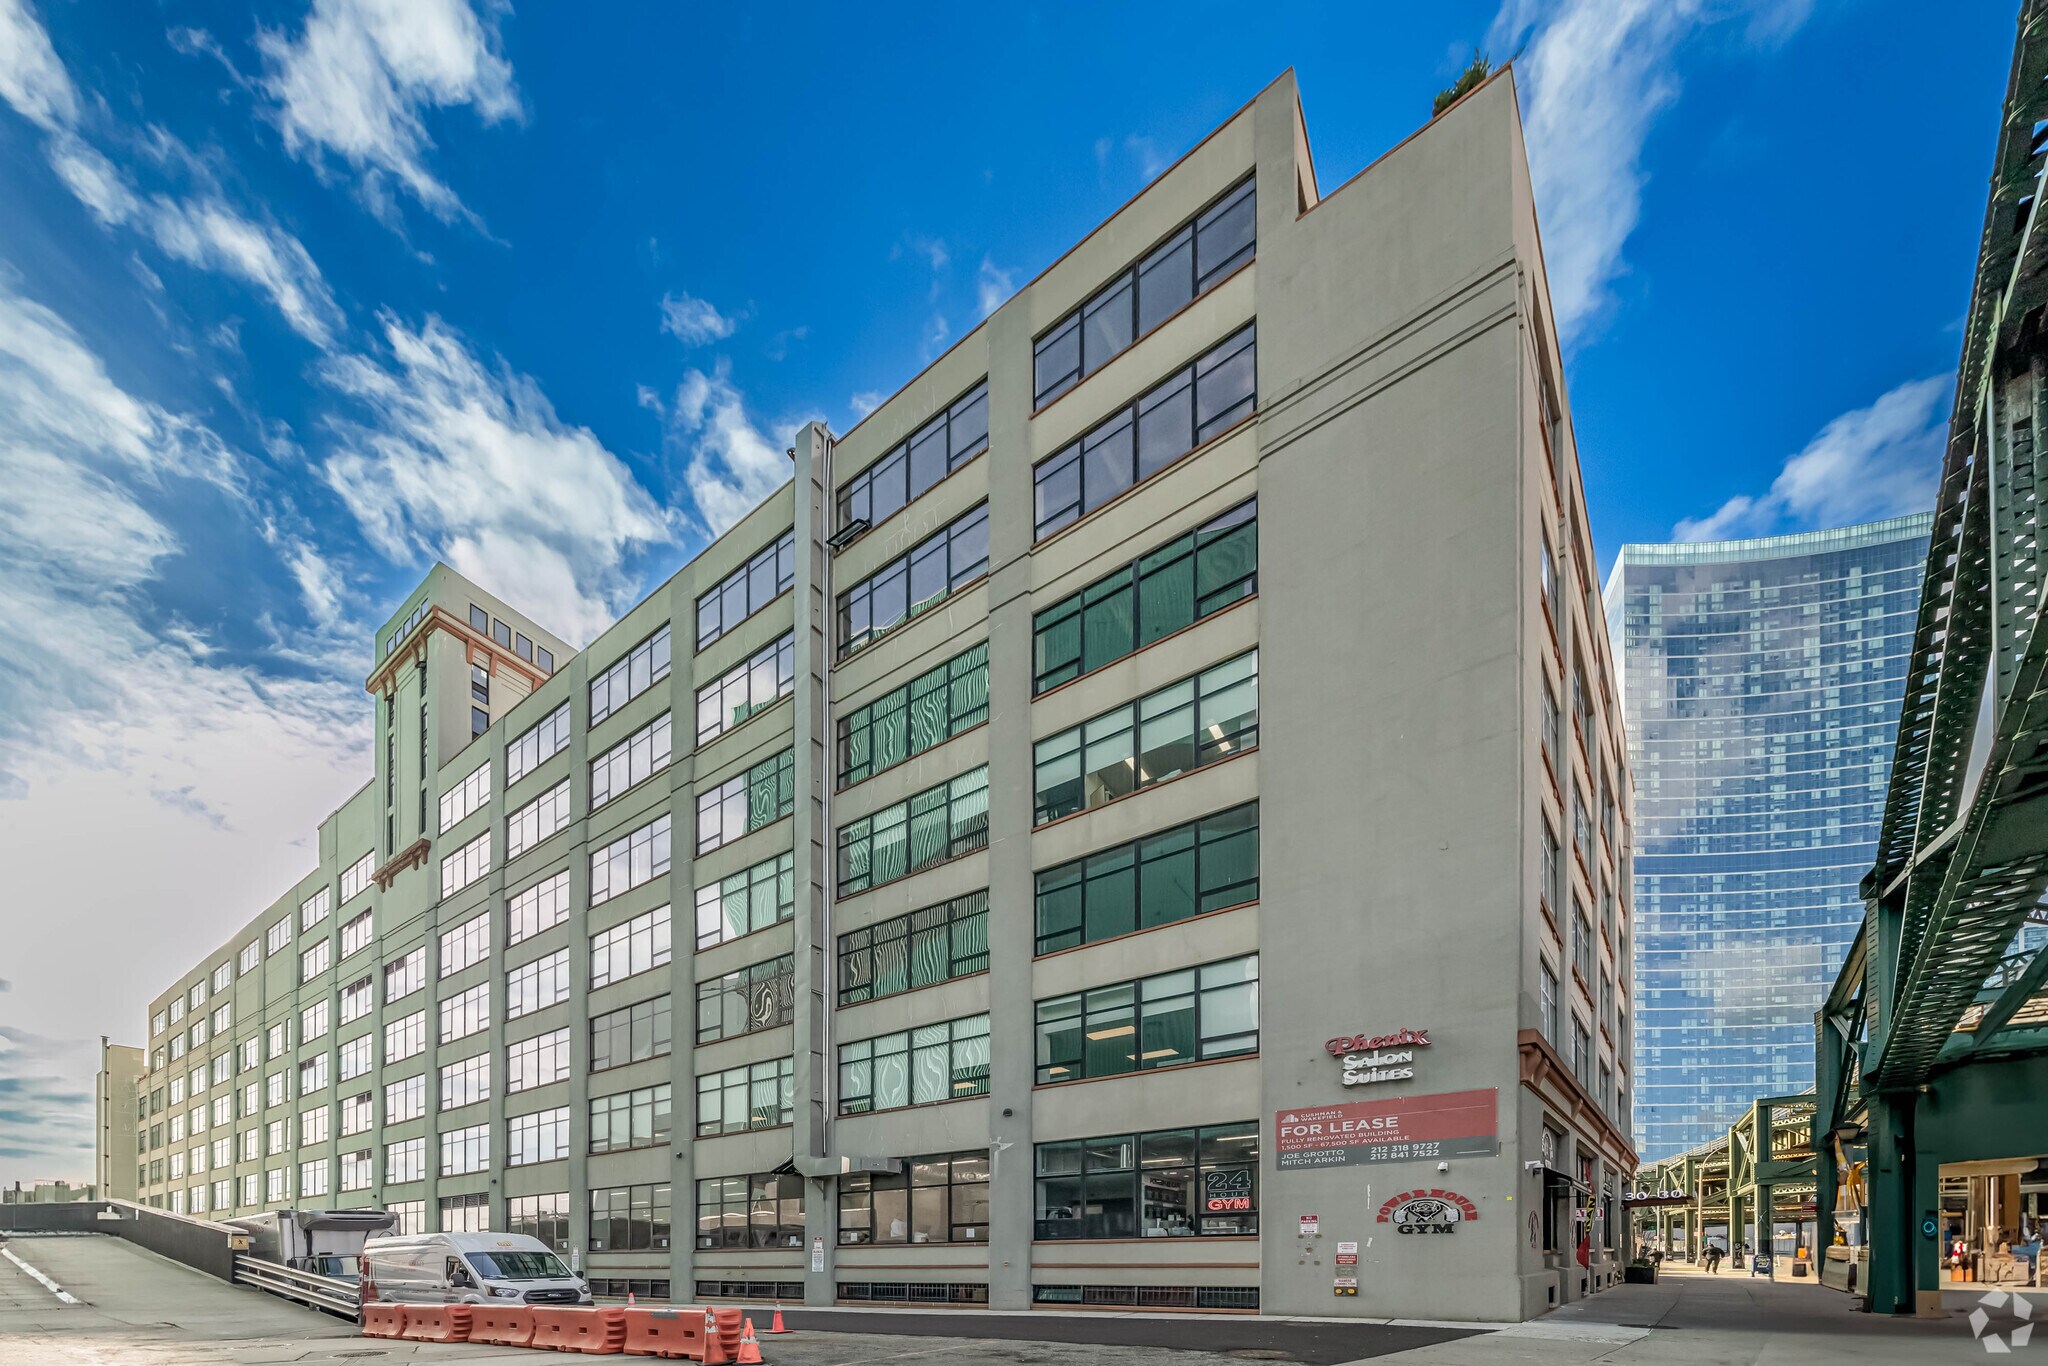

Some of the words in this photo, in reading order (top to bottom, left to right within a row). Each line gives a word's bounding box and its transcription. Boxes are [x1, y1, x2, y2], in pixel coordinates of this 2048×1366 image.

[1324, 1028, 1432, 1056] Phenix
[1300, 1114, 1343, 1122] WAKEFIELD
[1281, 1124, 1322, 1138] FOR
[1329, 1116, 1399, 1133] LEASE
[1307, 1133, 1356, 1142] RENOVATED
[1358, 1130, 1400, 1138] BUILDING
[1362, 1135, 1410, 1144] AVAILABLE
[1303, 1149, 1345, 1158] GROTTO
[1371, 1146, 1388, 1154] 212
[1391, 1144, 1409, 1152] 318
[1412, 1142, 1440, 1150] 9727
[1413, 1149, 1440, 1157] 7522
[1207, 1170, 1251, 1191] 24
[1207, 1198, 1250, 1211] GYM
[1376, 1189, 1478, 1223] POWERHOUSE
[1397, 1223, 1455, 1235] GYM
